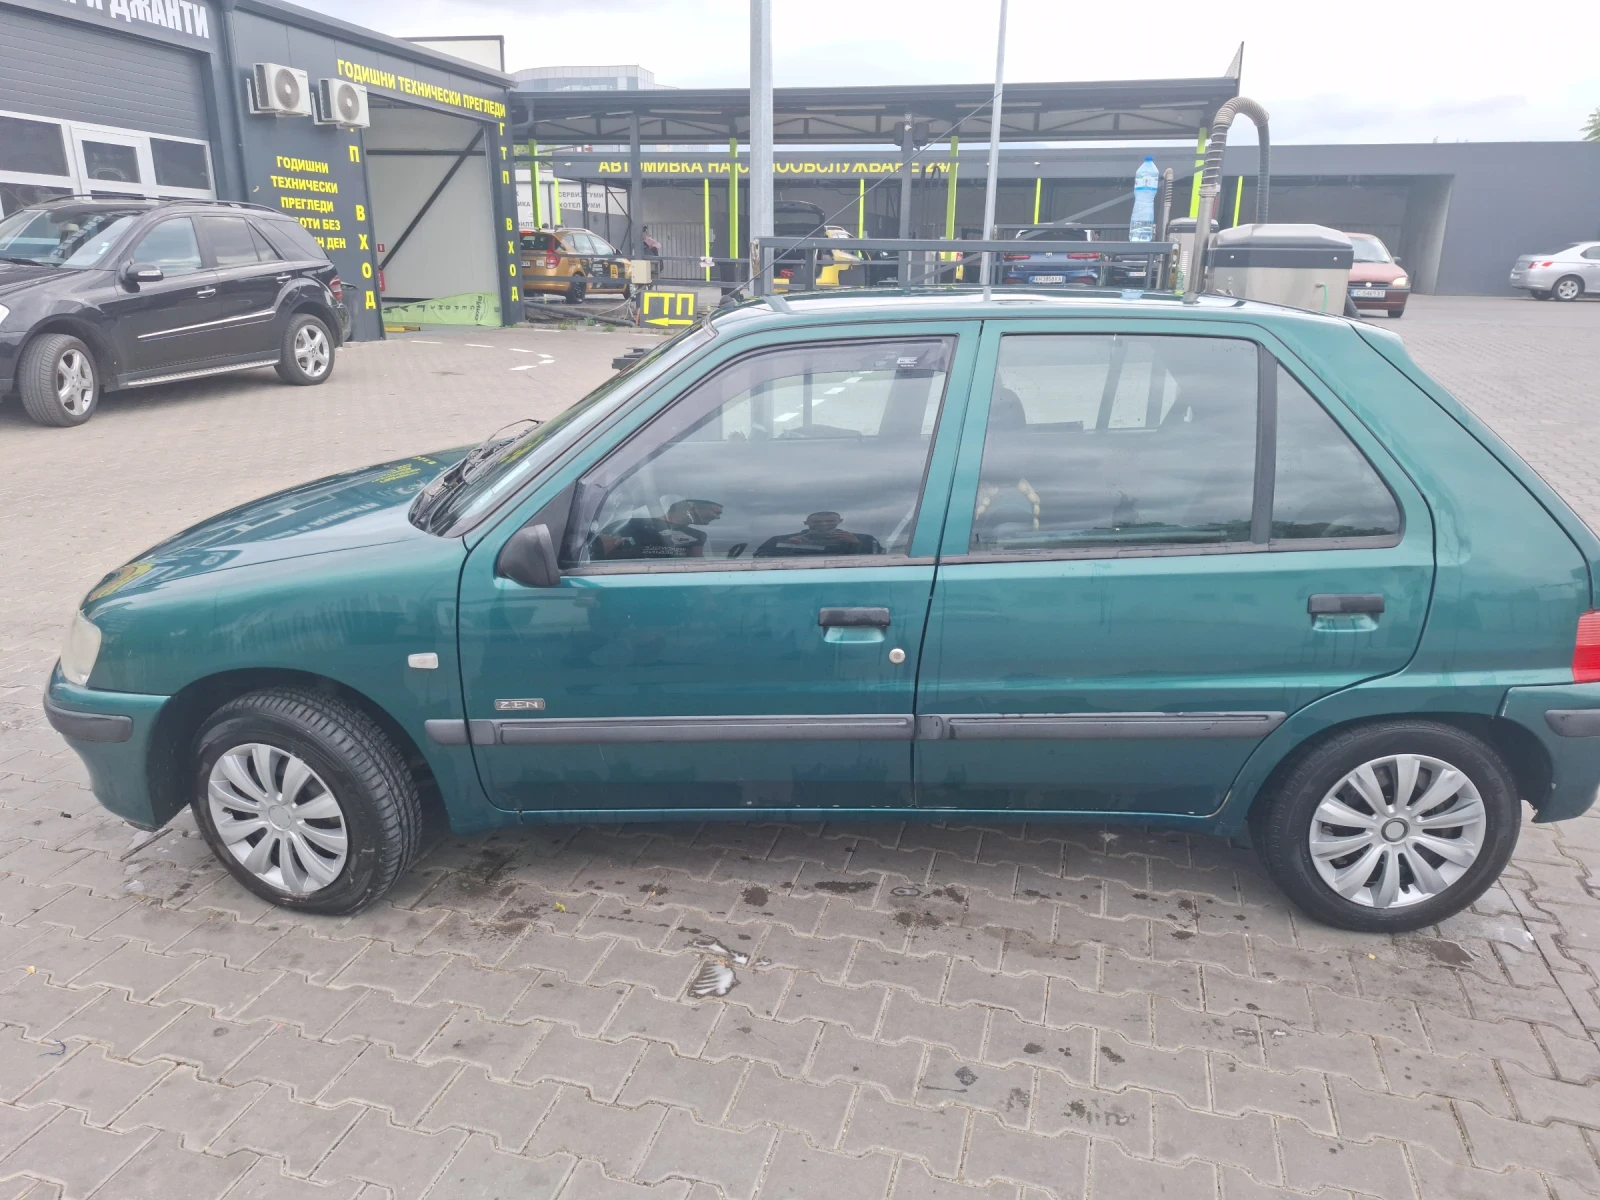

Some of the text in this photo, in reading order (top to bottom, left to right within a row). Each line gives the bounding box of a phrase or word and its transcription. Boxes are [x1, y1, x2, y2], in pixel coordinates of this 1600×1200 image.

[337, 59, 506, 118] ГОДИШНИ ТЕХНИЧЕСКИ ПРЕГЛЕДИ
[276, 155, 329, 174] ГОДИШНИ
[270, 175, 339, 194] ТЕХНИЧЕСКИ
[280, 196, 334, 214] ПРЕГЛЕДИ
[322, 218, 341, 231] БЕЗ
[326, 237, 347, 250] ДЕН
[355, 204, 376, 310] ВХОД
[643, 292, 695, 316] ГТП
[500, 700, 539, 709] ZEN
